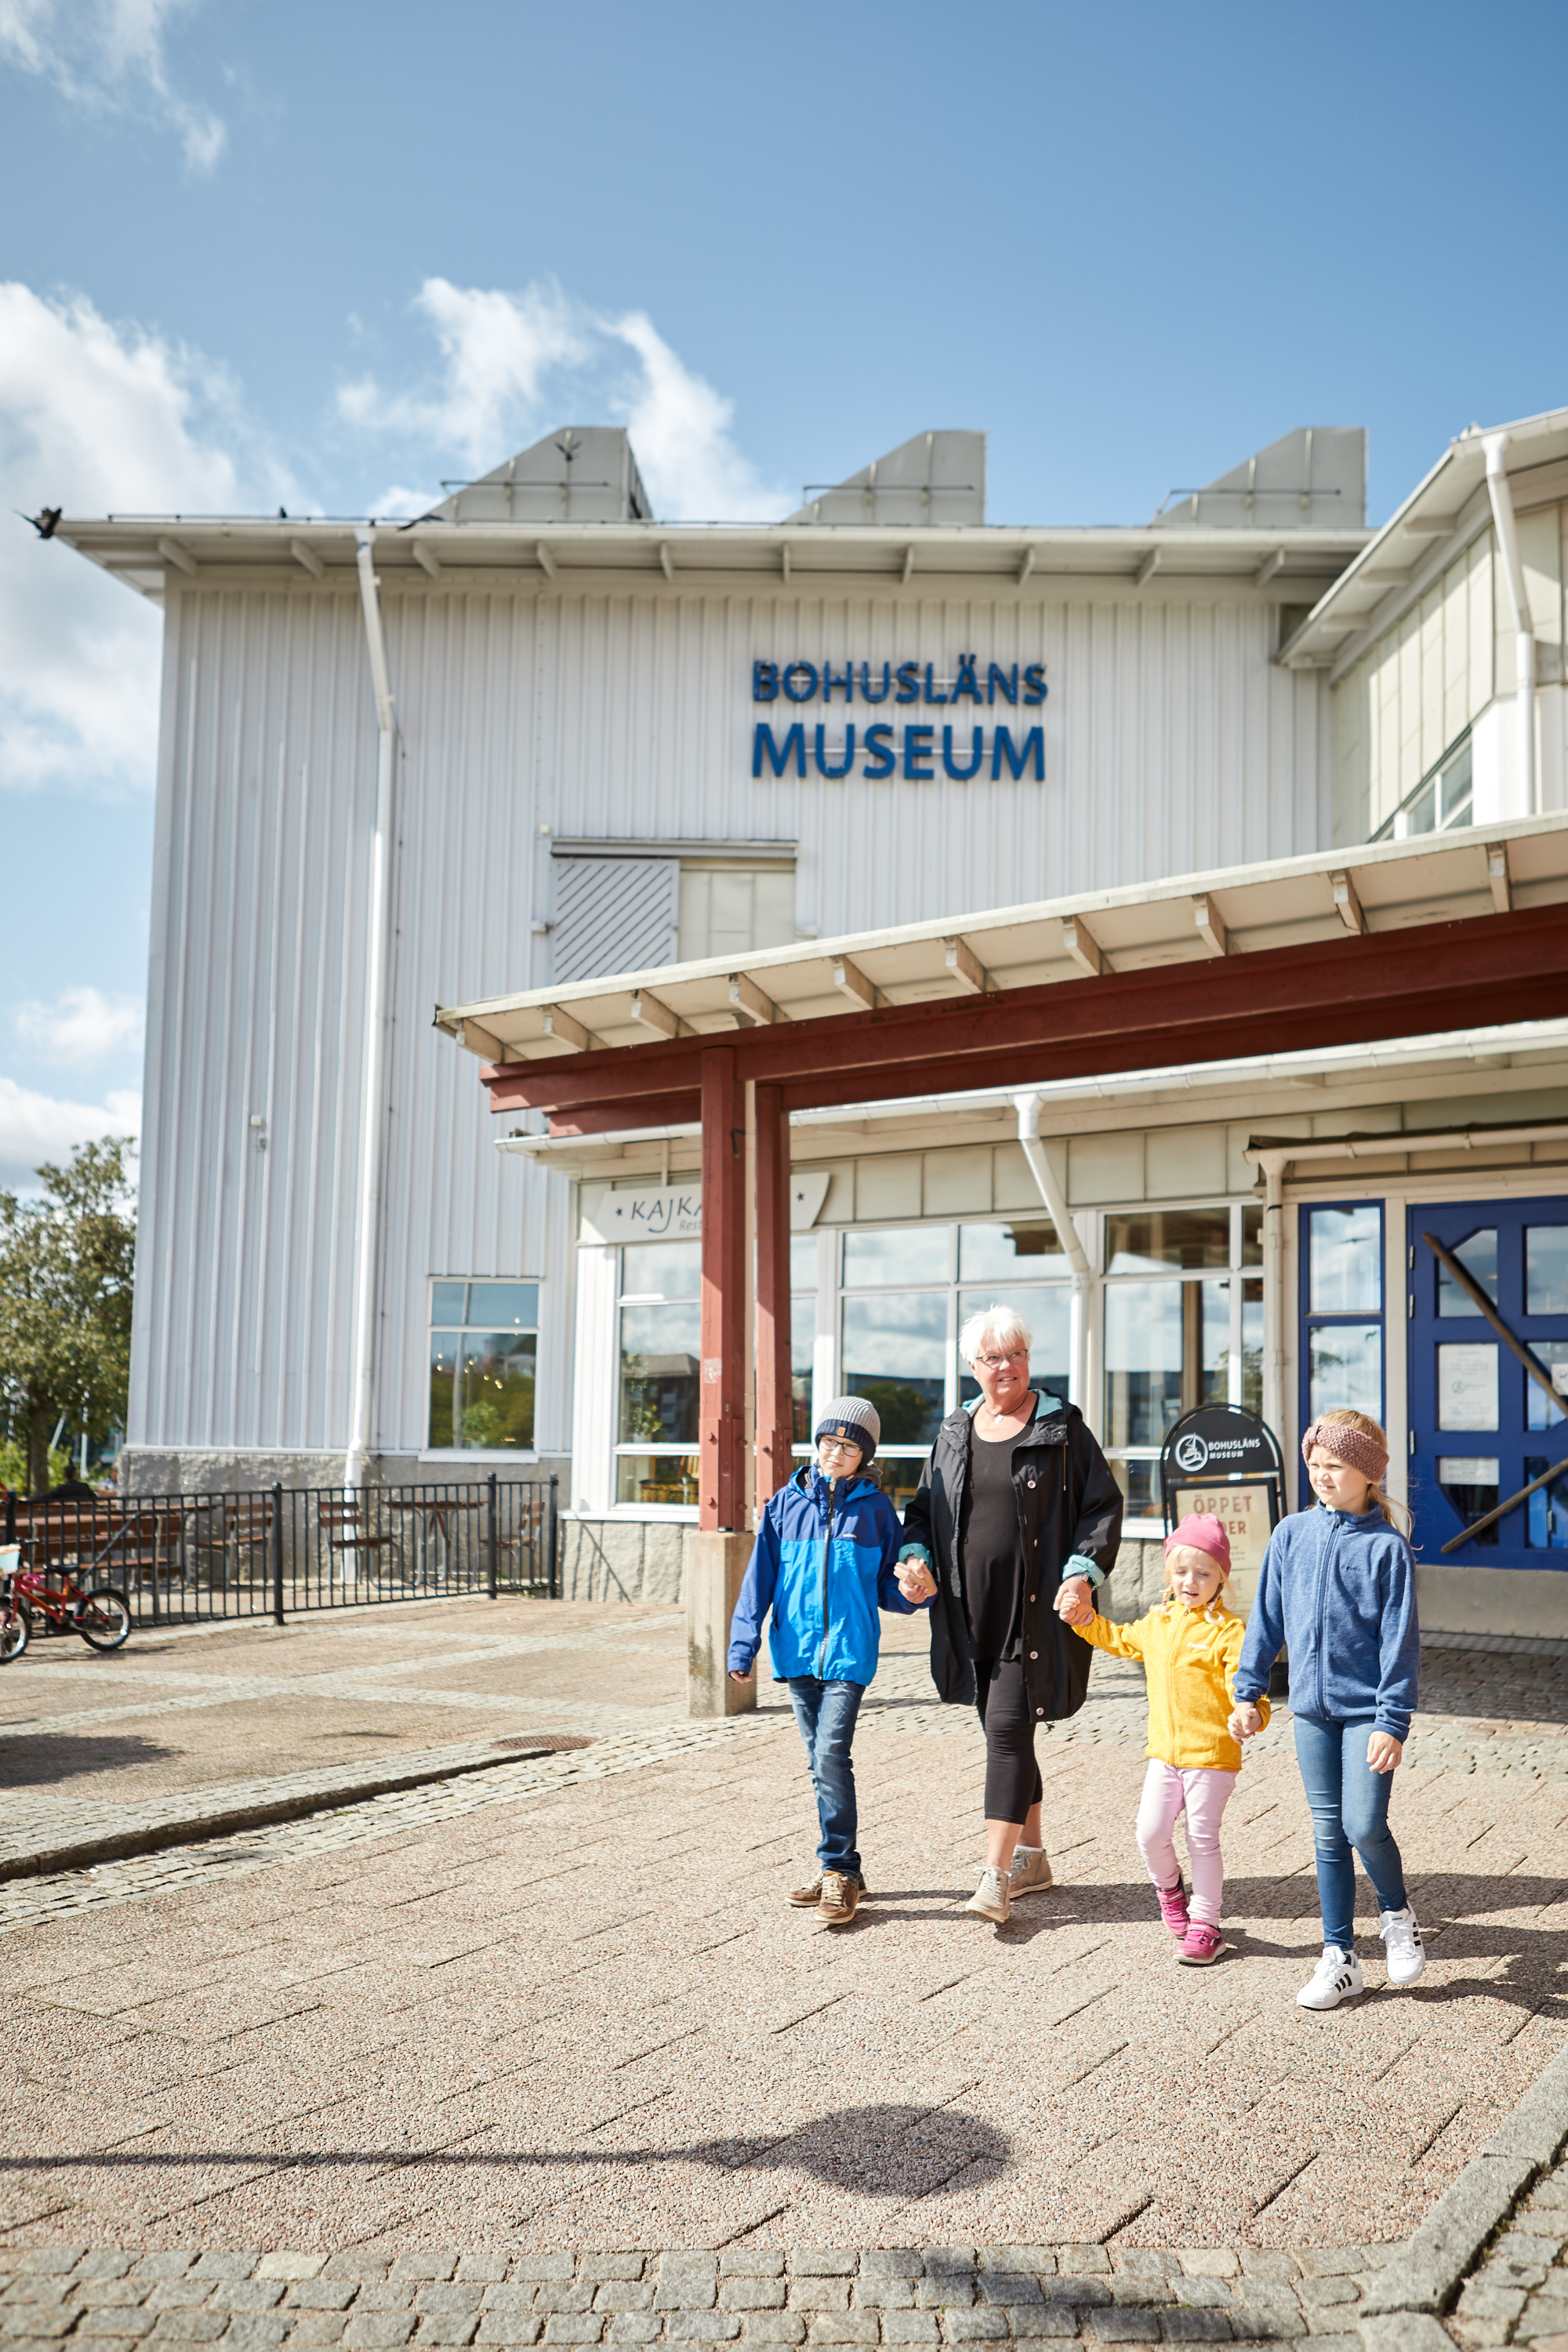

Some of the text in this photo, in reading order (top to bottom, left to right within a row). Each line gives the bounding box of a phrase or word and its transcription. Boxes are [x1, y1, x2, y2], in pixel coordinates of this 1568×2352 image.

[753, 654, 1047, 705] BOHUSLÄNS
[753, 723, 1045, 781] MUSEUM
[1208, 1438, 1261, 1450] BOHUSLÄNS
[1209, 1450, 1244, 1459] MUSEUM
[1193, 1494, 1252, 1514] ÖPPET
